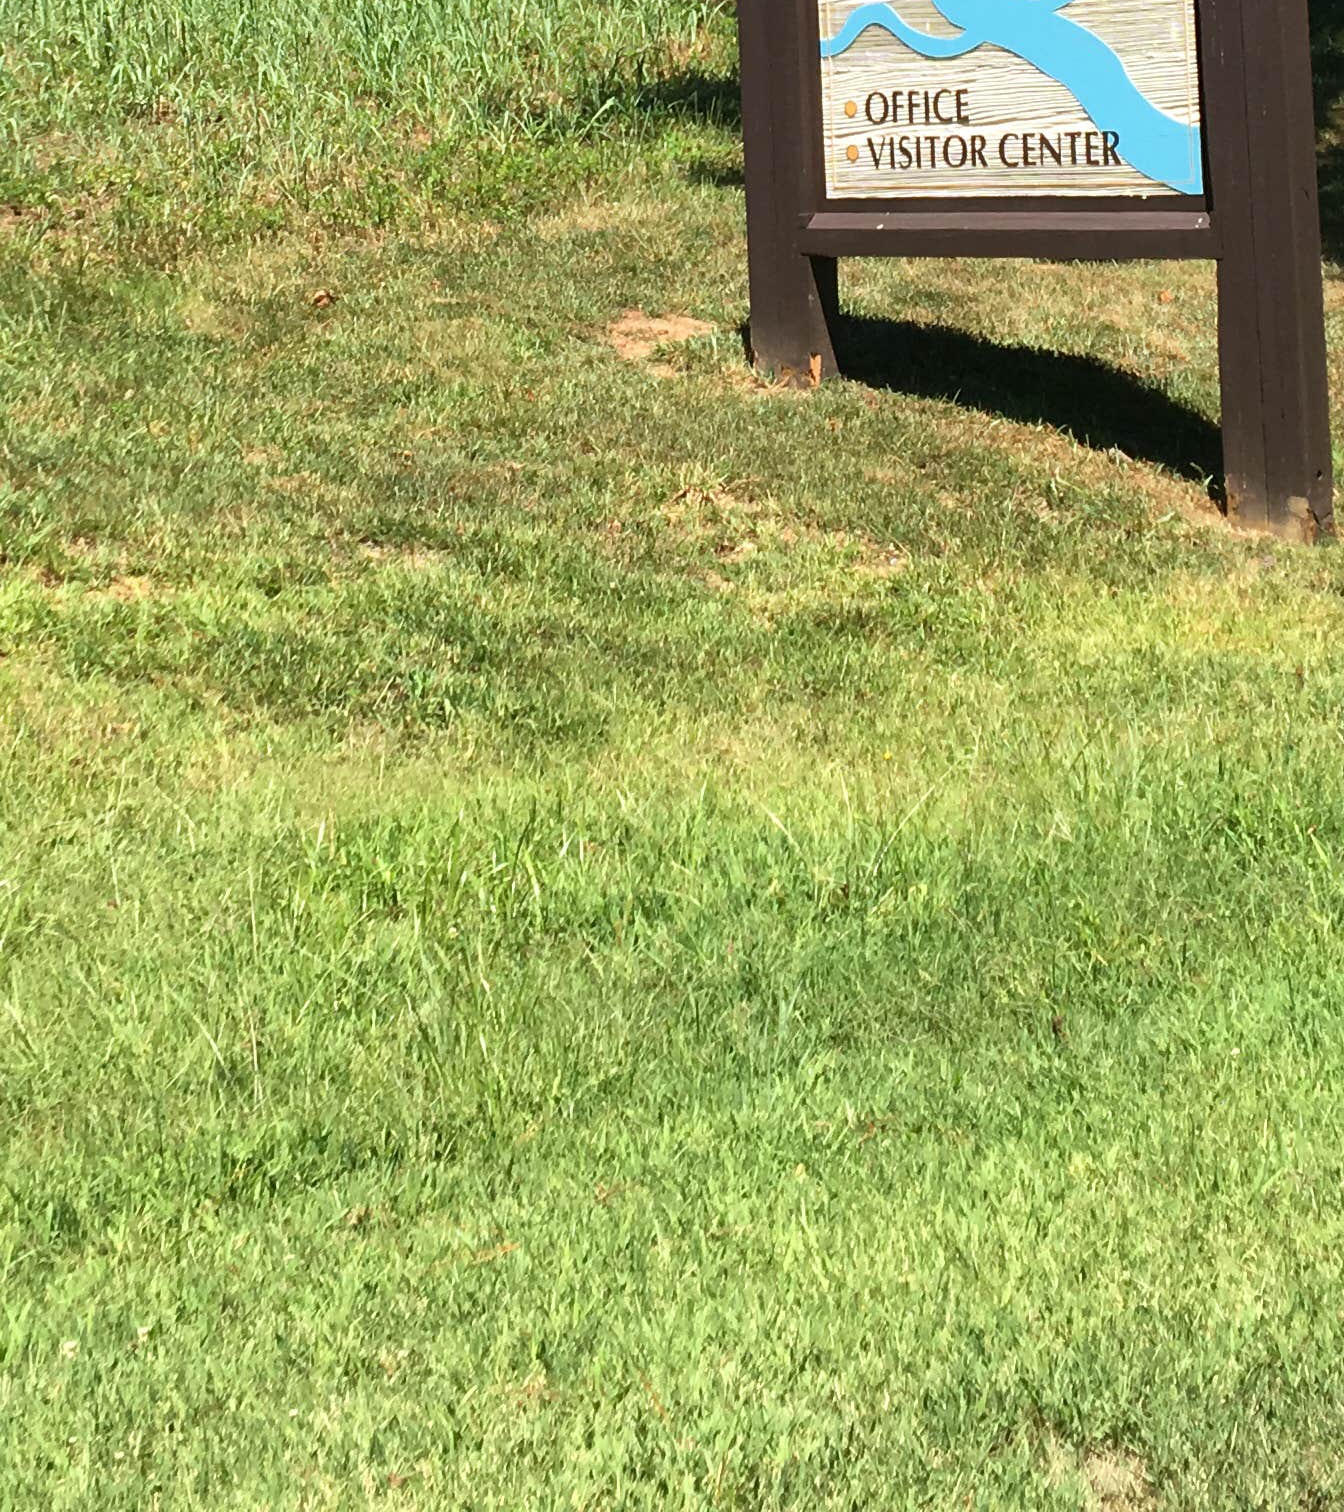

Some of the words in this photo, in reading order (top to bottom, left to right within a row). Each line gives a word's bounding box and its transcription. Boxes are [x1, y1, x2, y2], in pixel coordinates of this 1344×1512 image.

[865, 88, 969, 124] OFFICE
[867, 134, 989, 169] VISITOR
[998, 131, 1123, 168] CENTER
